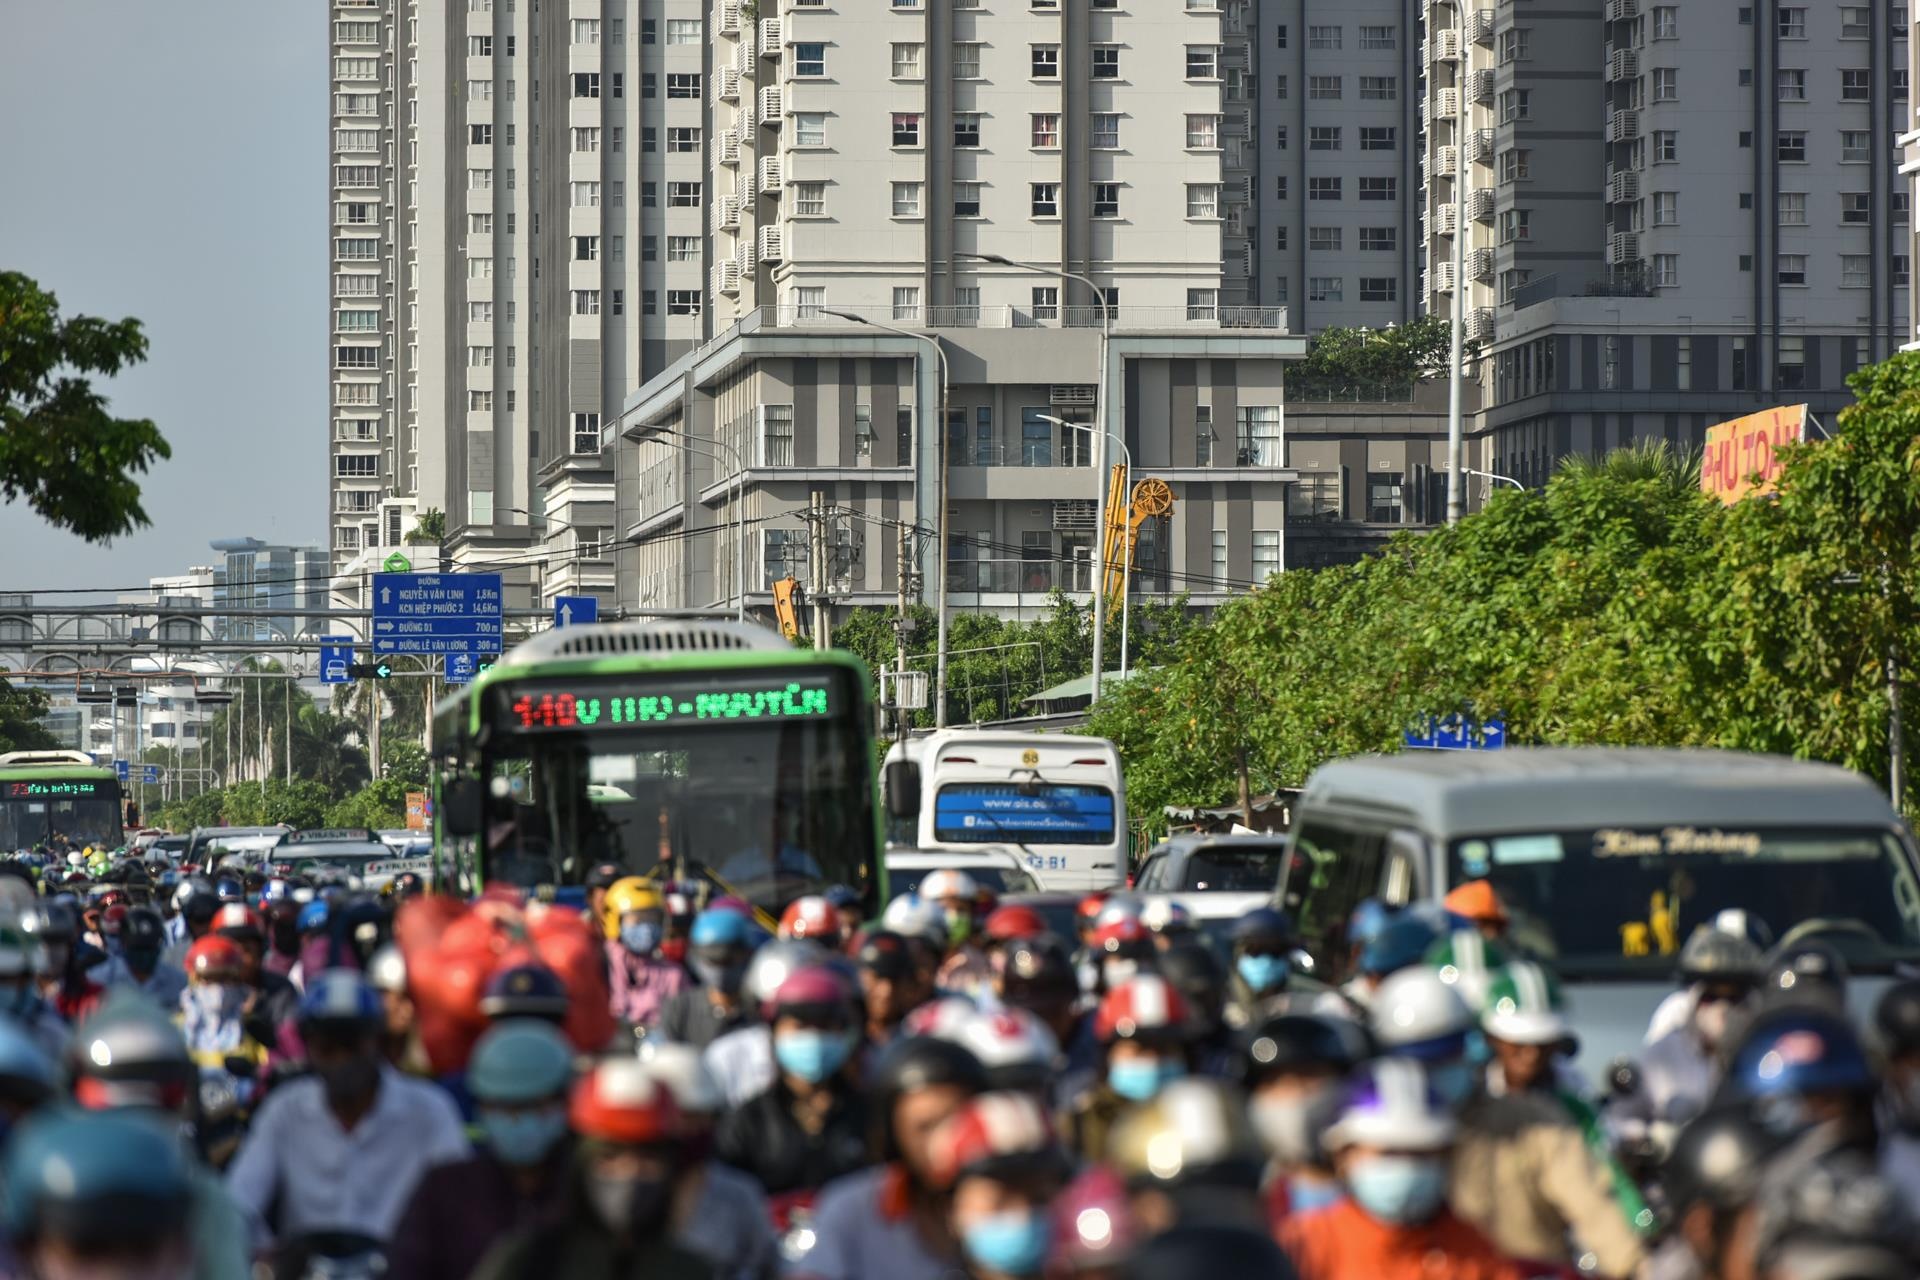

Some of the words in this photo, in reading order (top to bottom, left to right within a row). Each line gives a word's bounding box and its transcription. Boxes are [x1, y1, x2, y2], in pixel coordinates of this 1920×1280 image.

[399, 586, 427, 600] NGUYỄN
[447, 590, 464, 600] LINH
[399, 604, 414, 613] KCN
[415, 603, 431, 614] HIỆP
[458, 604, 464, 613] 2
[476, 623, 490, 632] 700
[477, 641, 490, 650] 300
